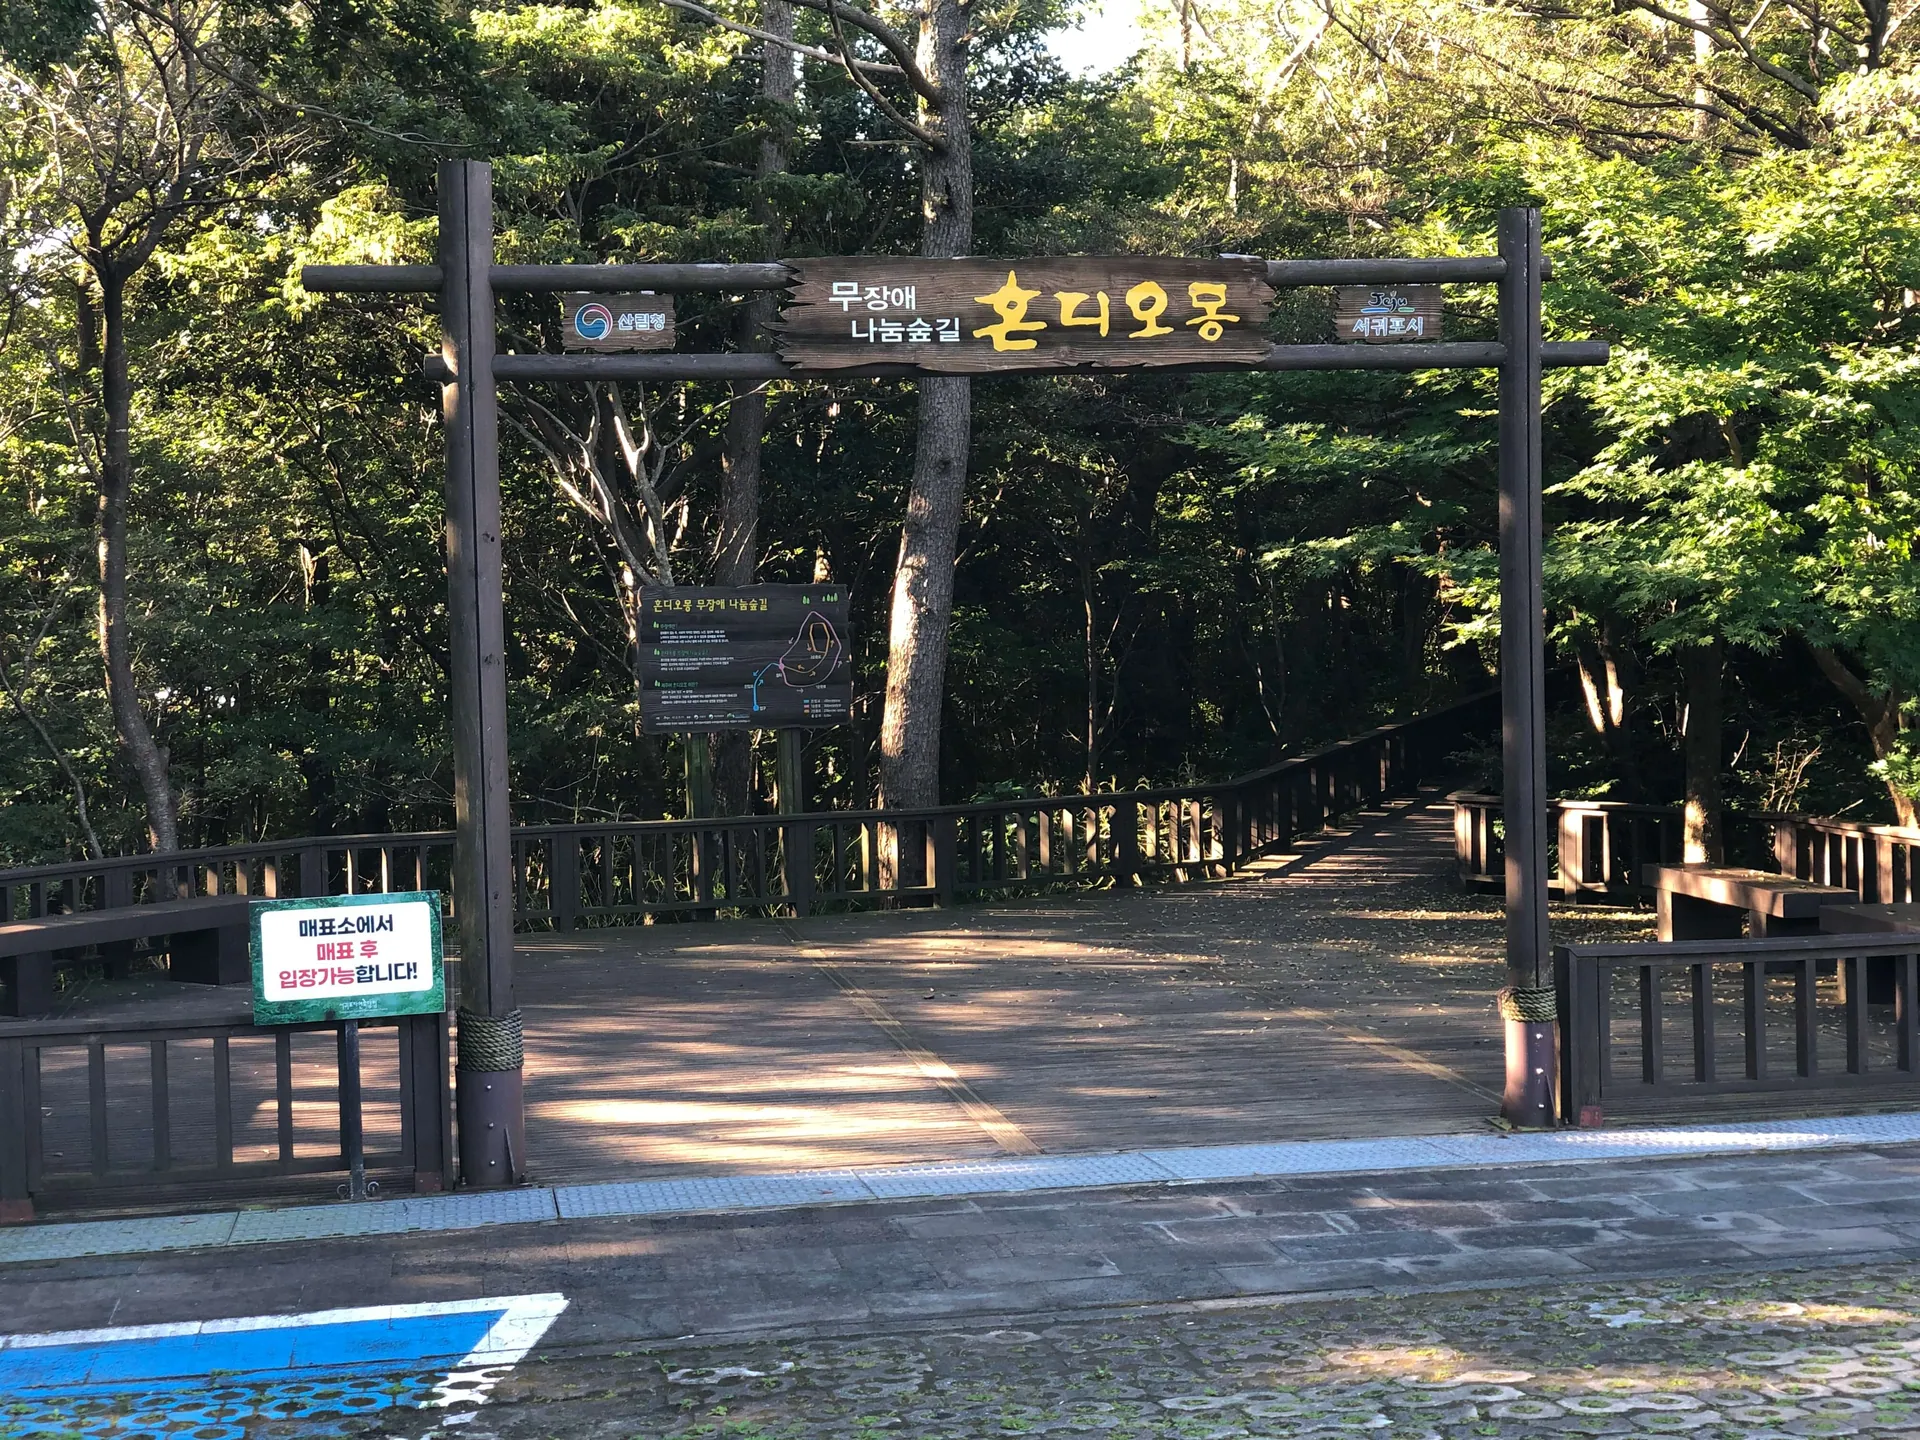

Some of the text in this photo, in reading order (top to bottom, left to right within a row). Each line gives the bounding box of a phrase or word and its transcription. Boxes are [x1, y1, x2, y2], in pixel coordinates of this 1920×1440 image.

[829, 282, 916, 312] 무장애
[1368, 290, 1408, 313] Jeju
[618, 313, 665, 331] 산림청
[973, 270, 1240, 351] 혼디오몽
[851, 317, 961, 343] 나눔숲길
[1352, 316, 1424, 337] 서귀포시
[653, 598, 768, 613] 혼디오몽 무장애 나눔숲길
[299, 914, 394, 937] 매표소에서
[317, 940, 379, 961] 매표 후
[279, 962, 418, 989] 입장가능합니다!
